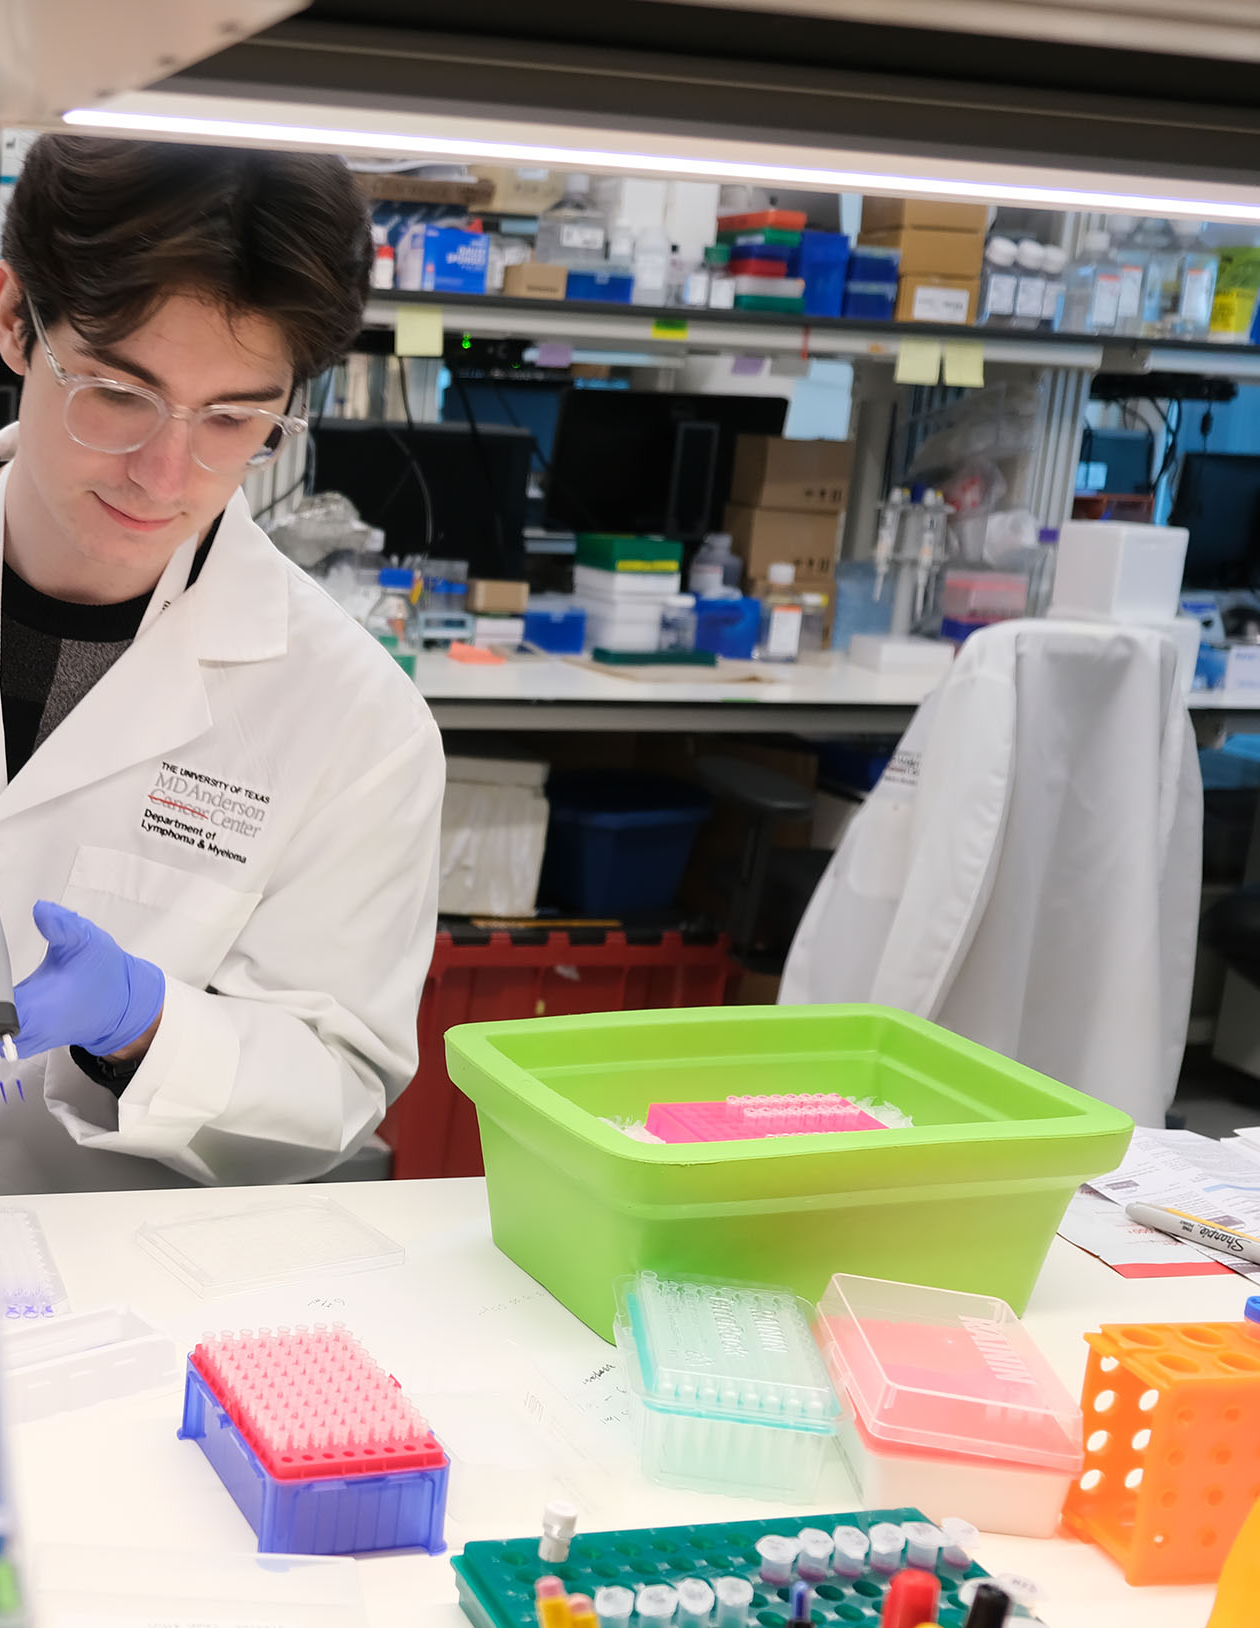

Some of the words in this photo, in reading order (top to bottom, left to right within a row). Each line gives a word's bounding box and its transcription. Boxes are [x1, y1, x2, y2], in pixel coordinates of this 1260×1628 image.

[154, 772, 188, 795] MD
[189, 785, 266, 822] Anderson
[161, 761, 178, 775] THE
[180, 767, 229, 791] UNIVERSITY
[230, 783, 243, 794] OF
[244, 788, 270, 804] TEXAS
[144, 808, 204, 837] Department
[205, 828, 217, 841] of
[148, 788, 210, 820] Cancer
[209, 810, 262, 838] Center
[141, 820, 195, 846] Lymphoma
[197, 838, 205, 849] &
[207, 843, 247, 864] Myeloma
[1198, 1225, 1251, 1252] Sharpie
[749, 1307, 788, 1353] RAININ
[958, 1314, 1037, 1385] RAININ
